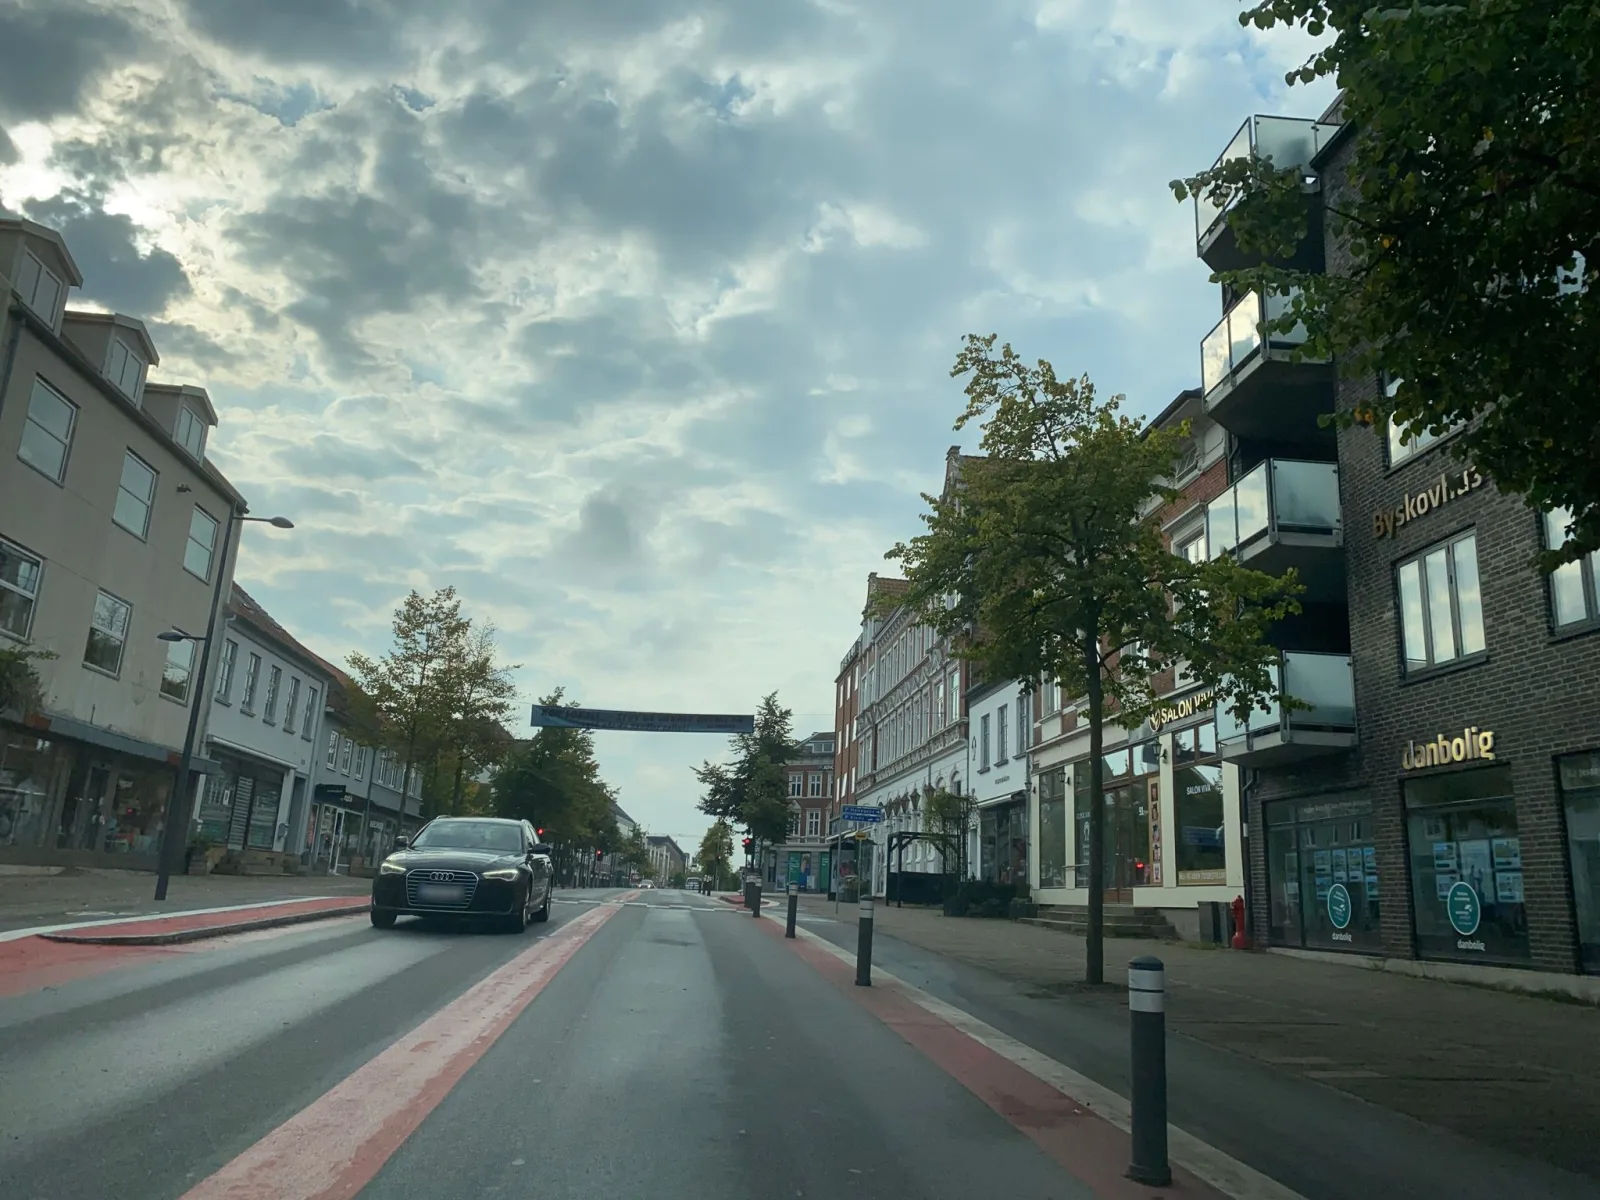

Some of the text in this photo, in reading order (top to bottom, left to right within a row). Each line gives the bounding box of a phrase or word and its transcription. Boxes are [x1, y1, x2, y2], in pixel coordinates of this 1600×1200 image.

[1161, 697, 1193, 724] SALON
[1402, 726, 1496, 770] danbolig
[1187, 784, 1201, 795] SALON
[1456, 939, 1486, 951] danbolig
